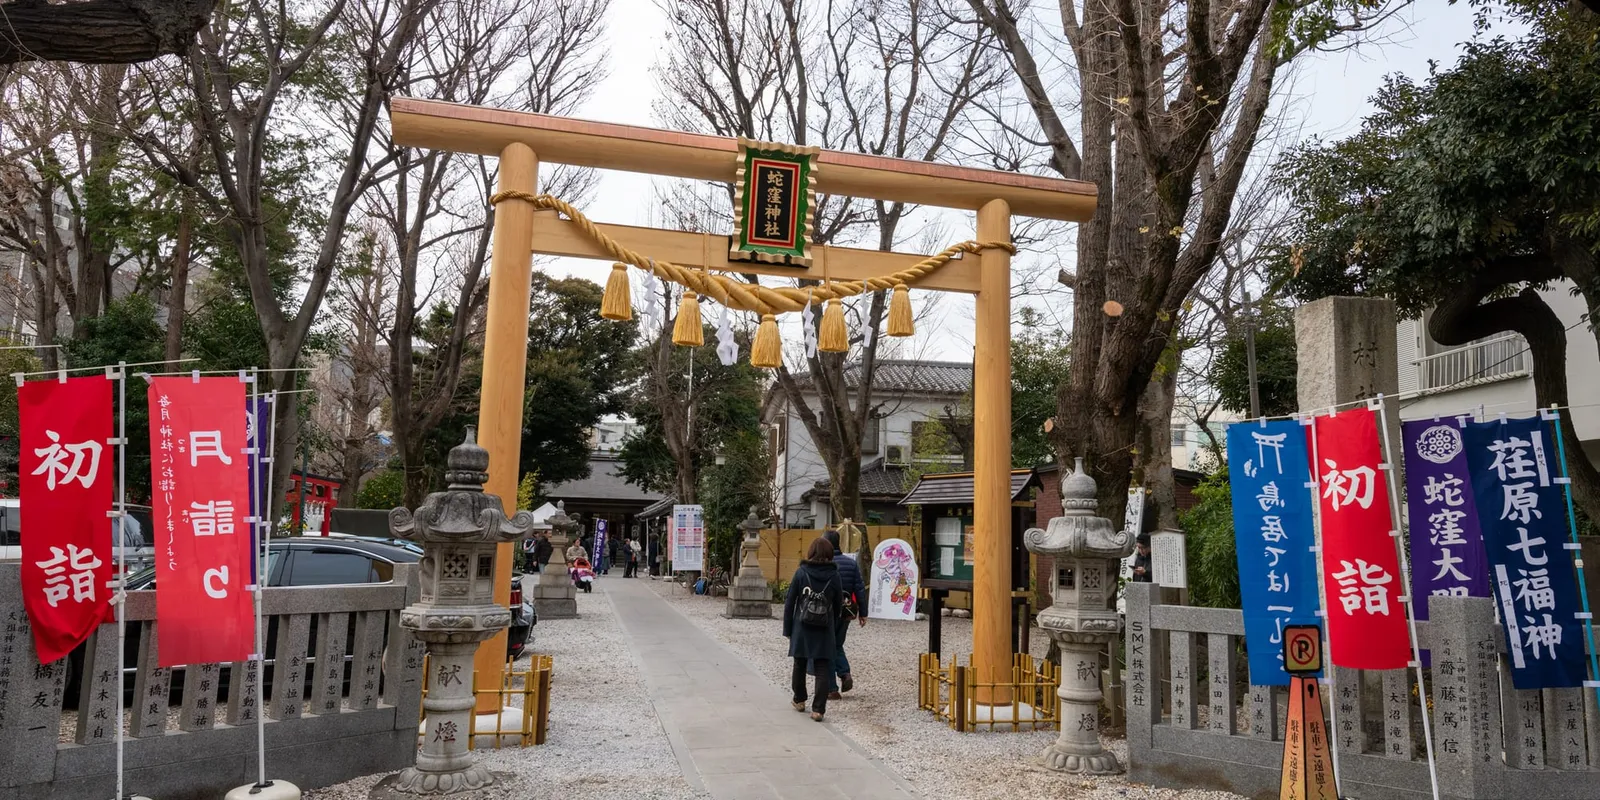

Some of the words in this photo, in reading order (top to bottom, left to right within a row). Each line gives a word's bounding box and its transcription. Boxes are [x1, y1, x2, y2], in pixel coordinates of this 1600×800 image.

[764, 170, 784, 236] 蛇窪神社
[31, 430, 103, 607] 初詣
[1322, 458, 1393, 616] 初詣
[1487, 436, 1563, 661] 荏原七福神
[146, 667, 163, 728] 石橋良一
[285, 656, 300, 714] 金子恒治
[433, 664, 462, 743] 献燈
[1077, 661, 1096, 732] 献燈
[1132, 621, 1145, 707] SMK株式会社
